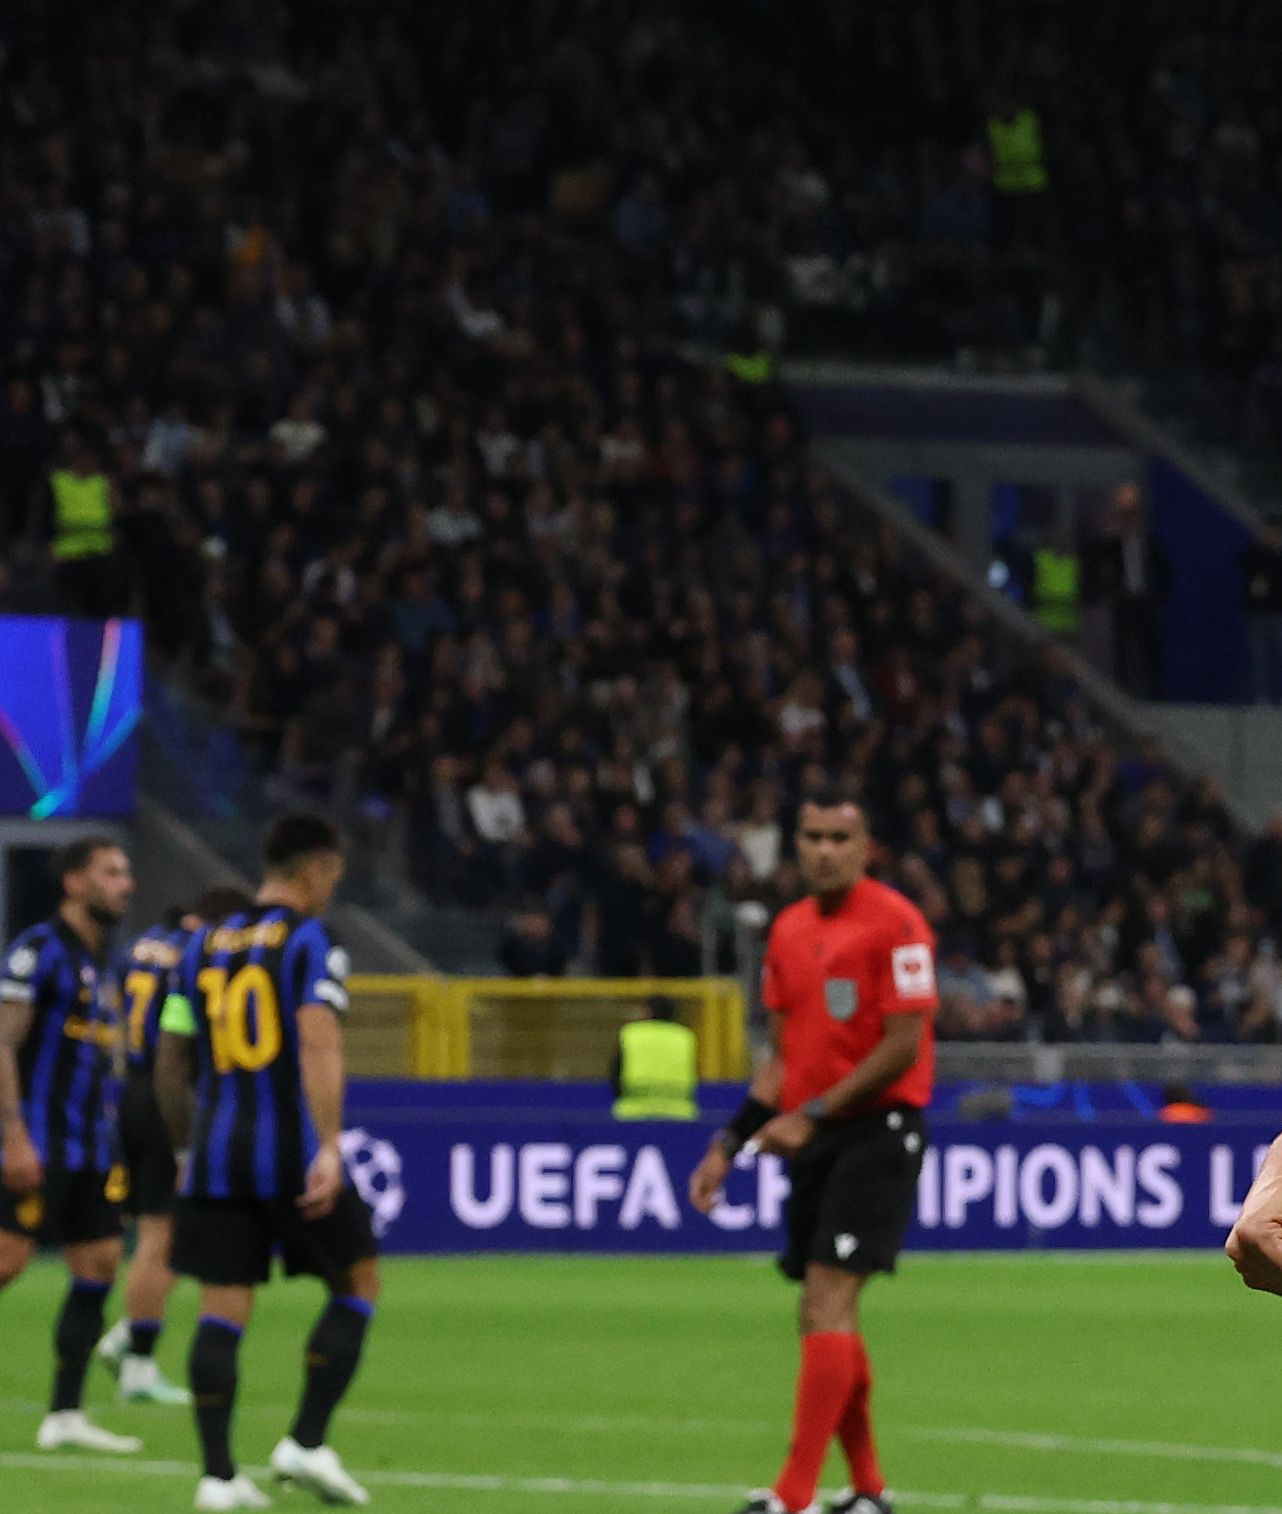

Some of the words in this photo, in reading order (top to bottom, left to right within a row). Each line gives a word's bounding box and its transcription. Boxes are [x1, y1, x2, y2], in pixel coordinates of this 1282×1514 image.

[198, 964, 283, 1074] 10
[450, 1142, 682, 1230] UEFA
[702, 1142, 1184, 1230] CHPIONS
